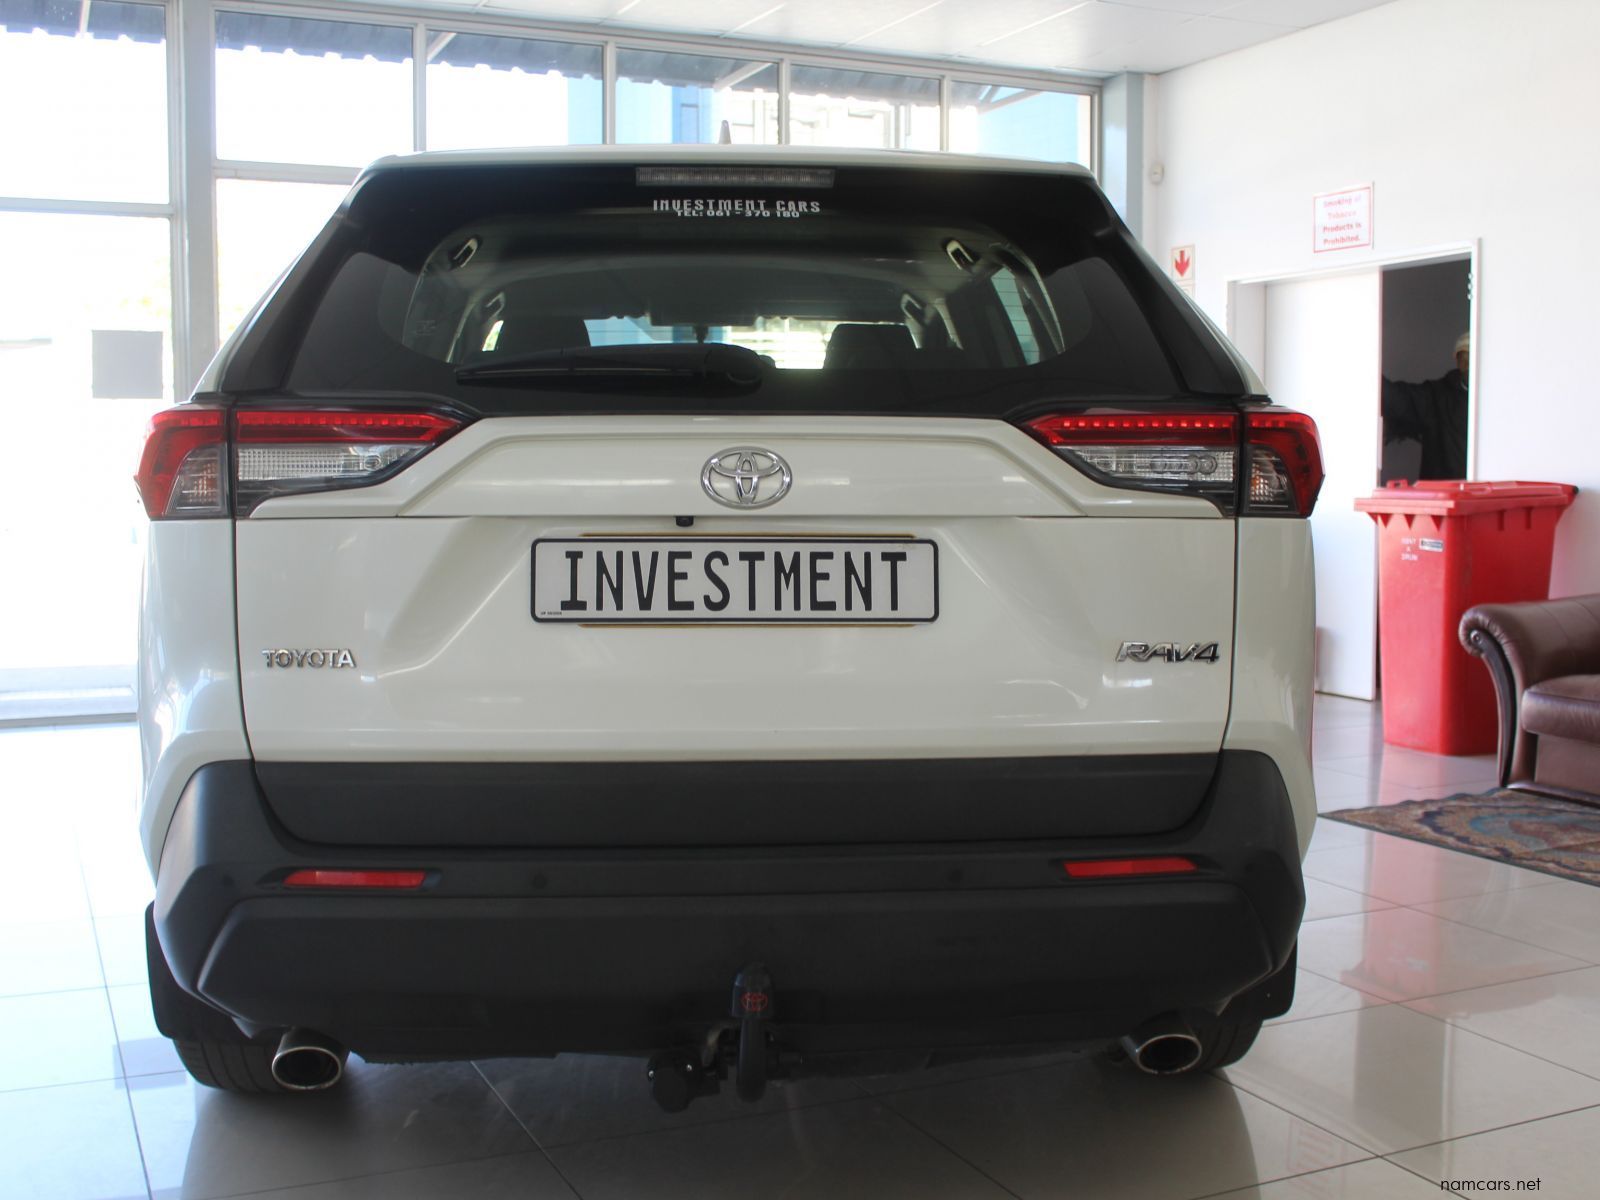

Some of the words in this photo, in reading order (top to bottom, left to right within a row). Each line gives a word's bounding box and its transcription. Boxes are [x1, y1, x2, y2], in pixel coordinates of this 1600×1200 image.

[653, 199, 766, 211] INVESTMENT
[776, 200, 821, 213] CARS
[1323, 223, 1354, 233] Products
[560, 550, 908, 612] INVESTMENT
[261, 648, 357, 669] TOYOTA
[1115, 640, 1220, 664] RAV4
